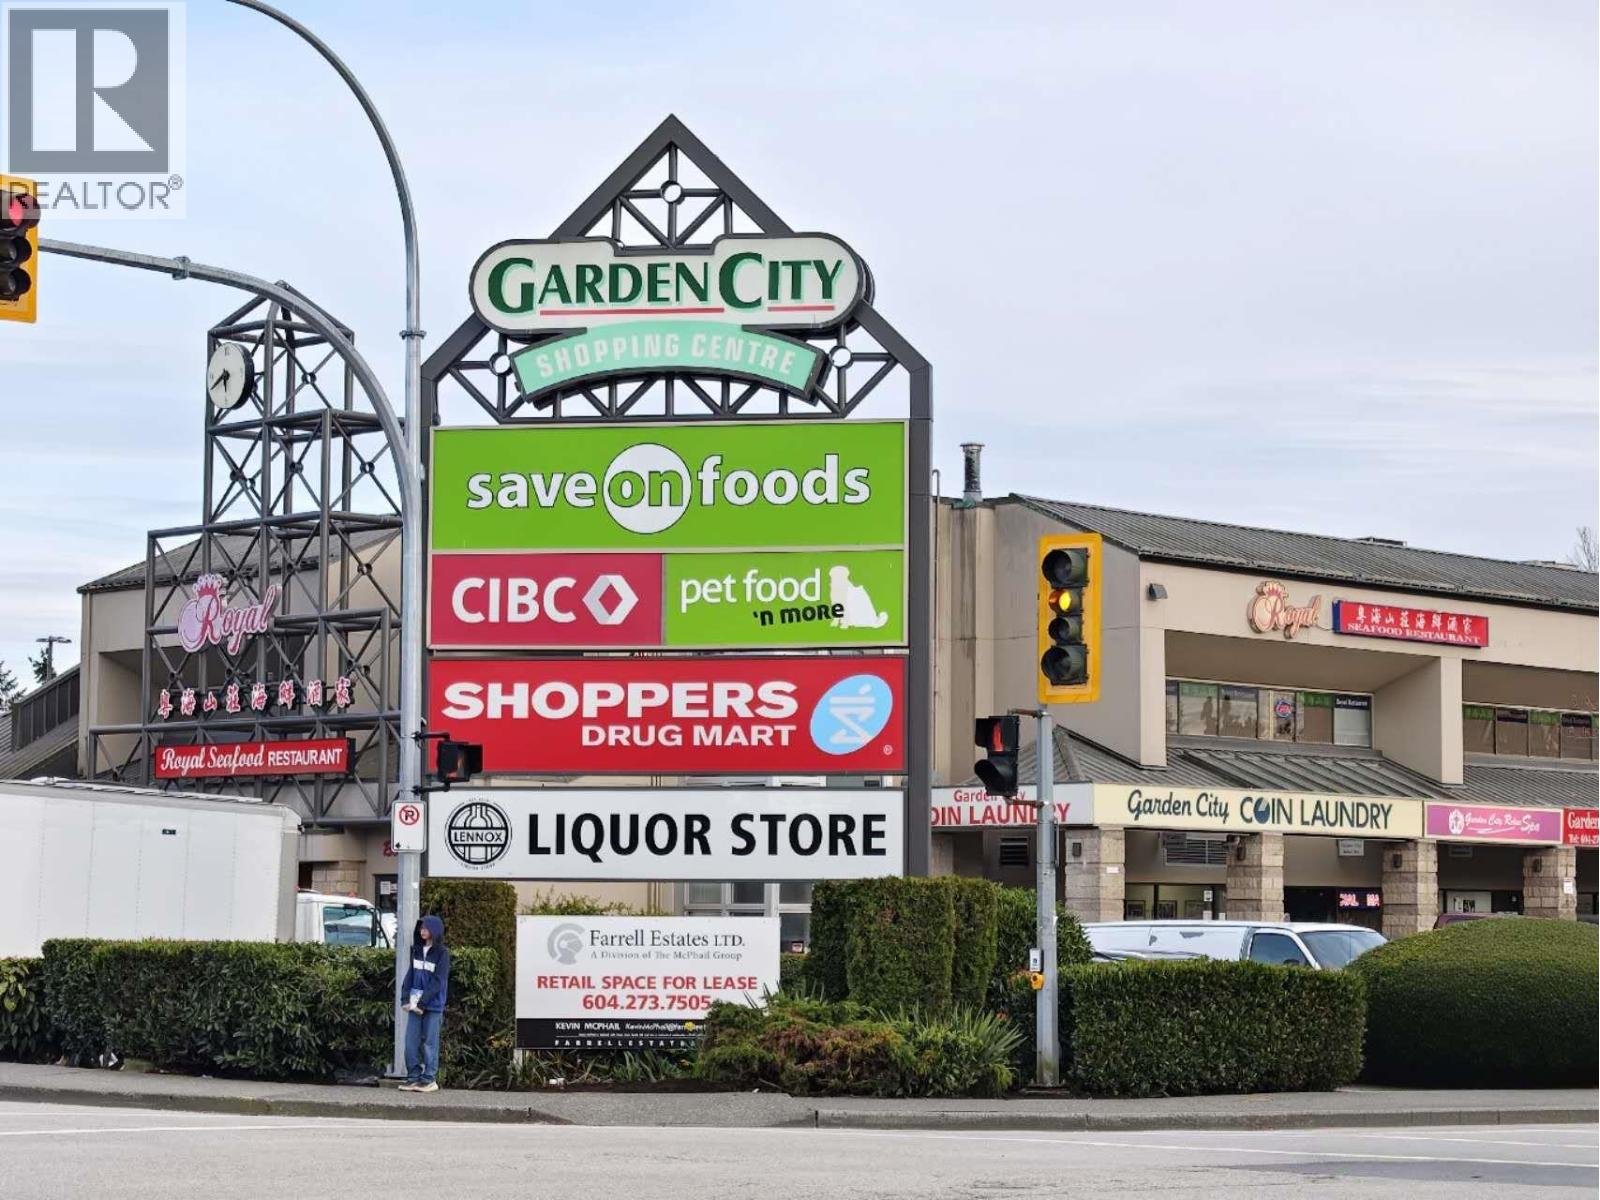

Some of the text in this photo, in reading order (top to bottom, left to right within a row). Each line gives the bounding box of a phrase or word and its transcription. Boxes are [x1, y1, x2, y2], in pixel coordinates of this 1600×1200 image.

[488, 252, 843, 314] GARDEN CITY
[535, 333, 796, 378] SHOPPING CENTRE
[451, 576, 578, 623] CIBC
[680, 568, 822, 614] pet food
[178, 583, 282, 656] Royal
[1248, 594, 1323, 639] Royal
[1347, 623, 1481, 644] SEAFOOD RESTAURANT
[441, 680, 800, 720] SHOPPERS
[581, 725, 797, 747] DRUG MART
[161, 744, 343, 776] Royal Seafood RESTAURANT
[1127, 788, 1393, 829] Garden City COIN LAUNDRY
[453, 831, 503, 843] LENNOX
[528, 812, 887, 863] LIQUOR STORE
[589, 928, 745, 947] Farrell Estates LTD.
[601, 950, 639, 960] Division
[642, 950, 651, 960] of
[655, 950, 669, 960] The
[673, 950, 710, 960] McPhail
[713, 951, 743, 962] Group
[537, 975, 758, 991] RETAIL SPACE FOR LEASE
[582, 994, 712, 1011] 604.273.7505
[555, 1022, 581, 1031] KEVIN
